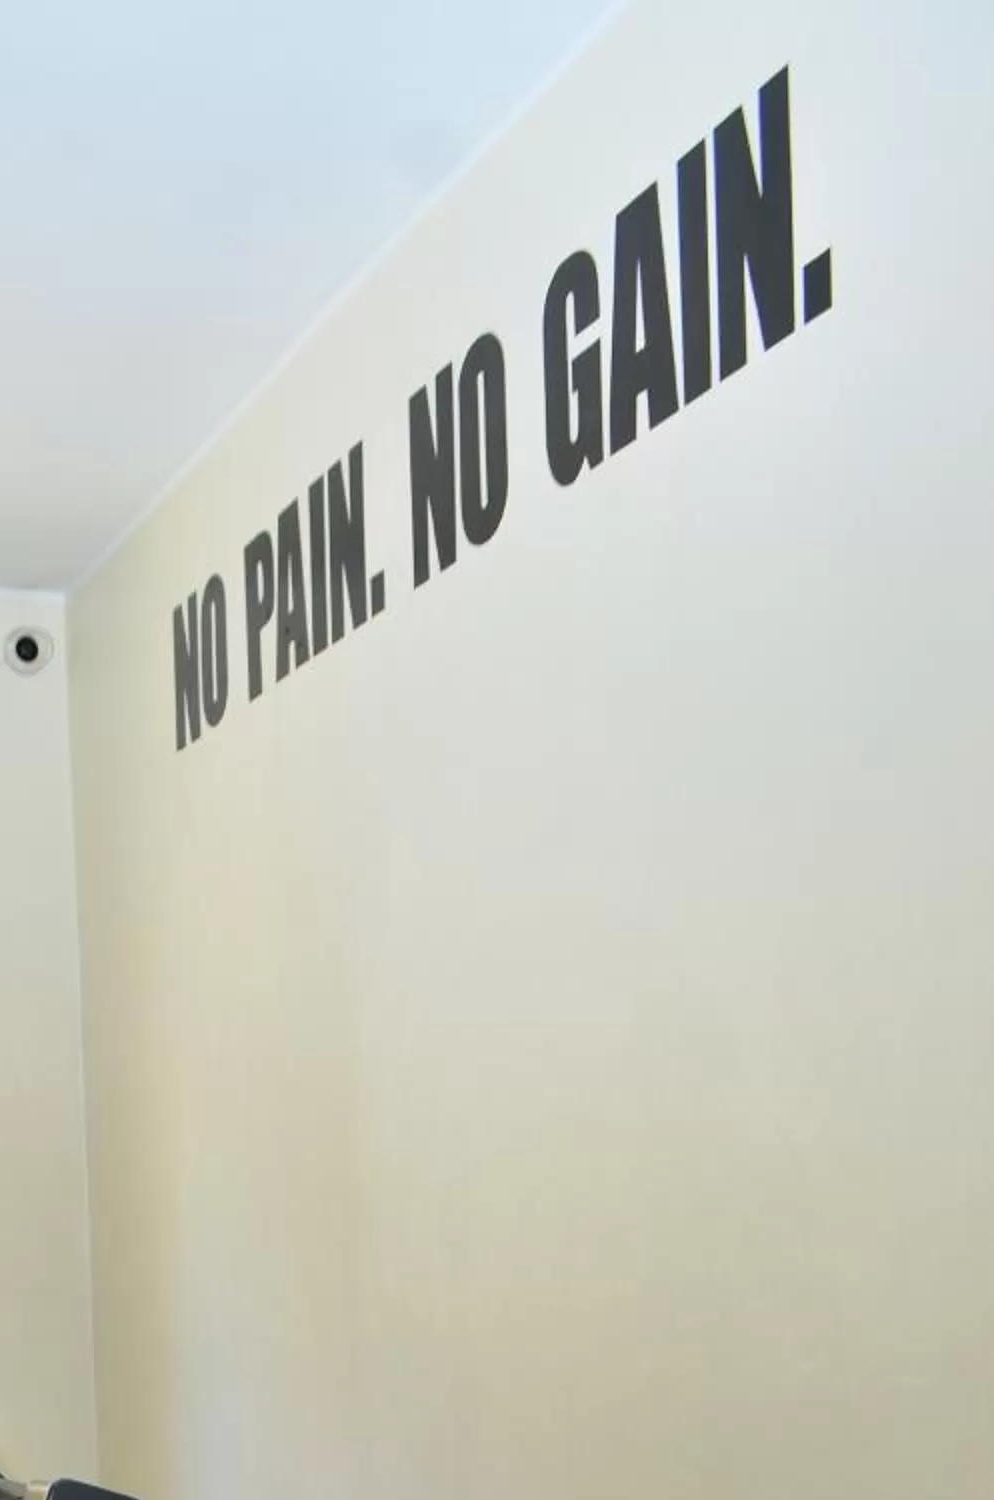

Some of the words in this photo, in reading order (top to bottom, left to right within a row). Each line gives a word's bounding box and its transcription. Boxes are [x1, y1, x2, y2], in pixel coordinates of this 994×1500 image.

[172, 574, 228, 751] NO
[244, 439, 385, 702] PAIN.
[409, 332, 509, 590] NO
[543, 64, 833, 487] GAIN.
